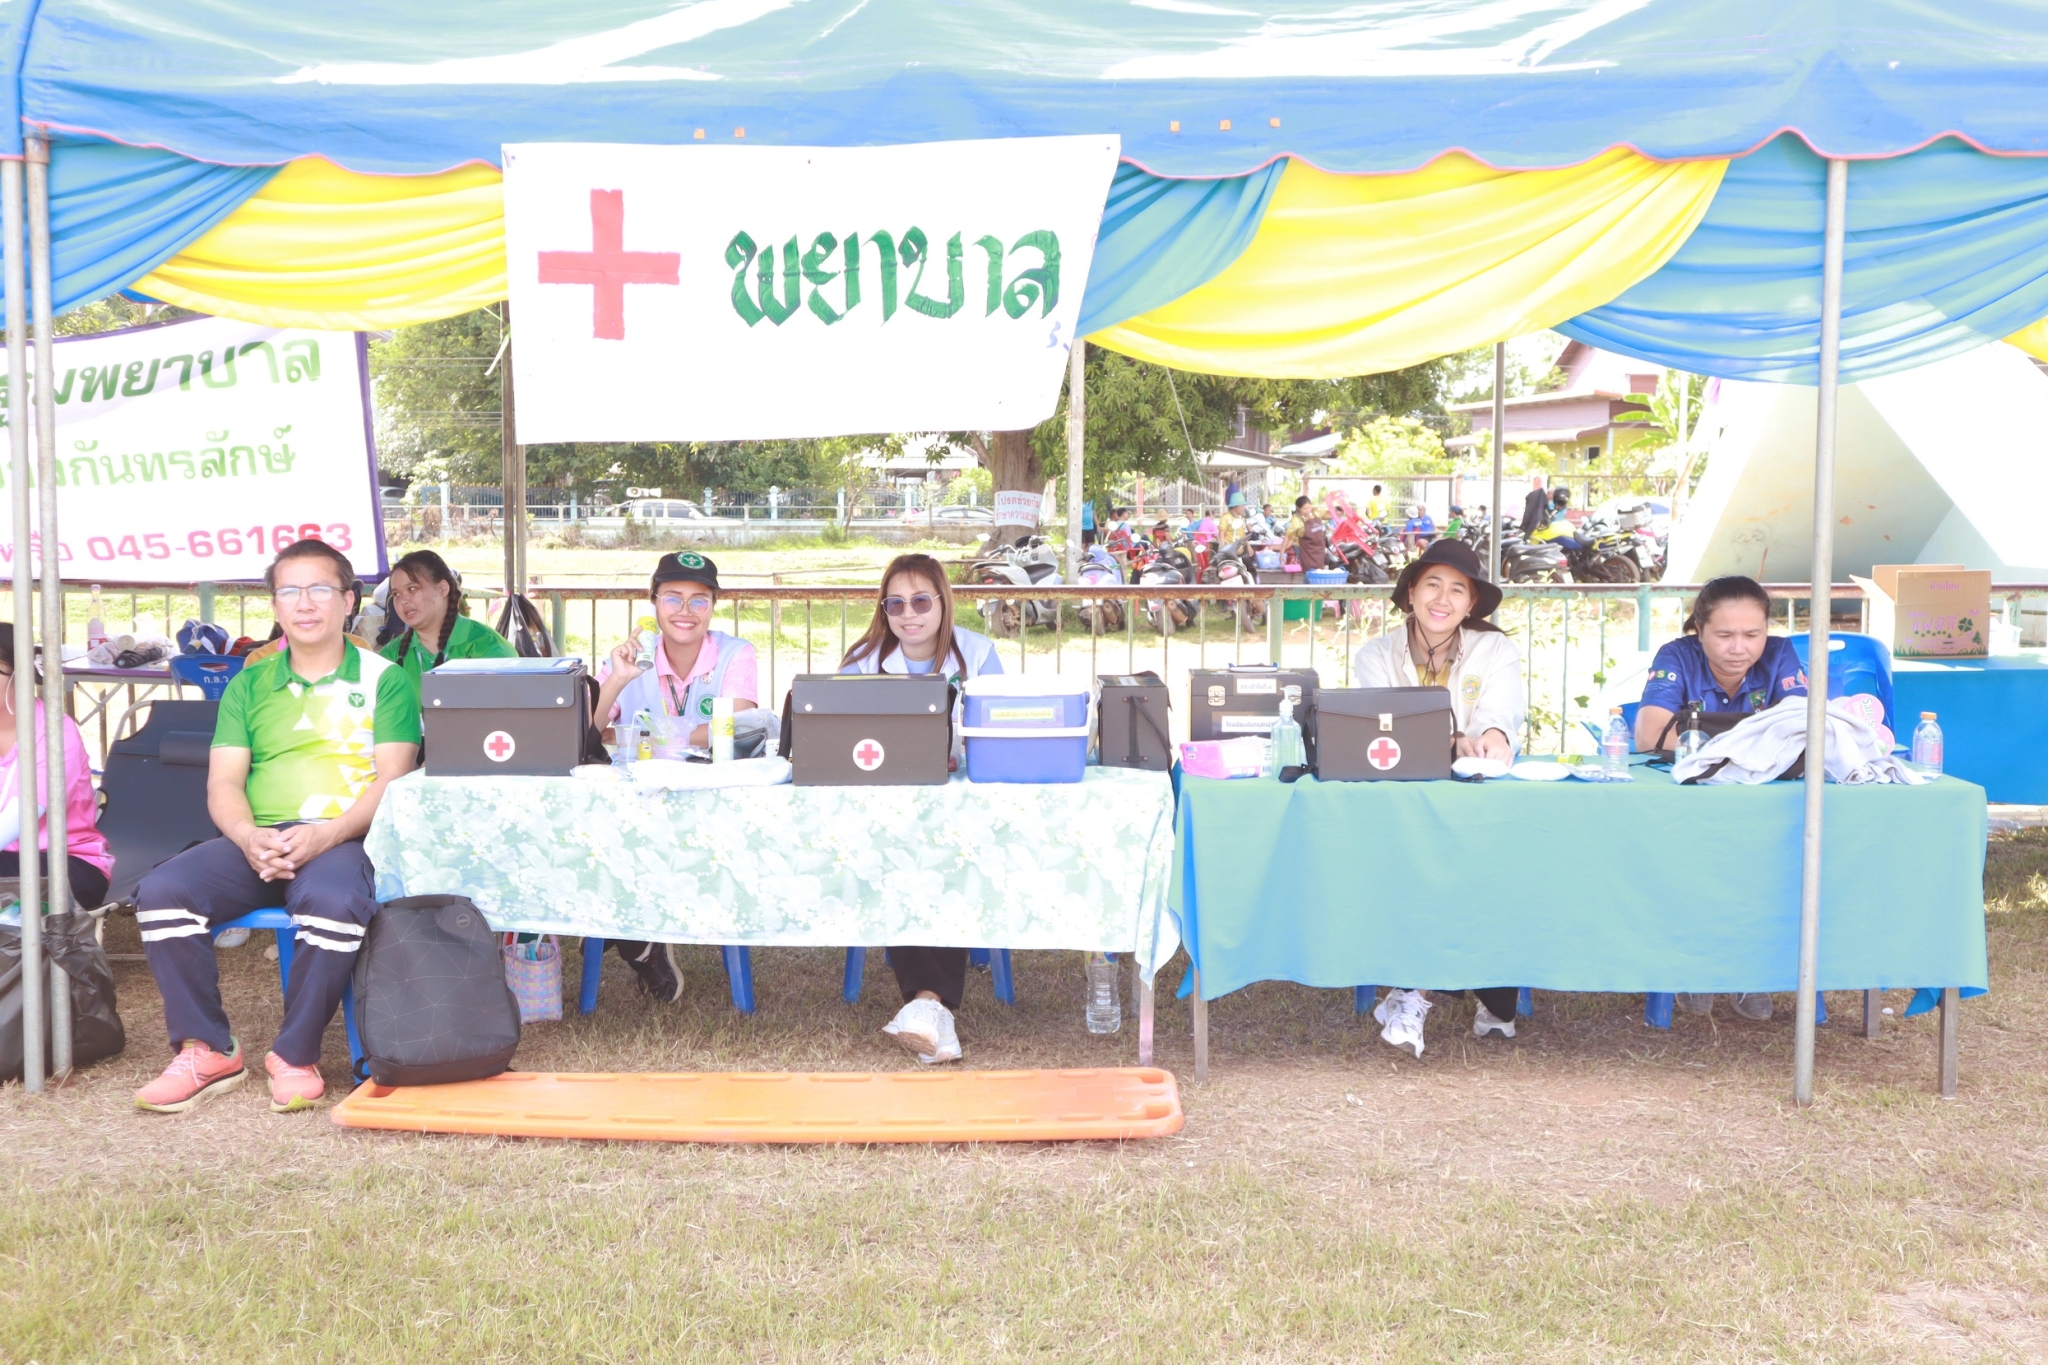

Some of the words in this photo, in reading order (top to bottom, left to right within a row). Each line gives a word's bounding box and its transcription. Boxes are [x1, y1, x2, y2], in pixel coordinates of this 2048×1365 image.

[724, 226, 1062, 327] พยาบาล
[1862, 698, 1875, 719] Safe
